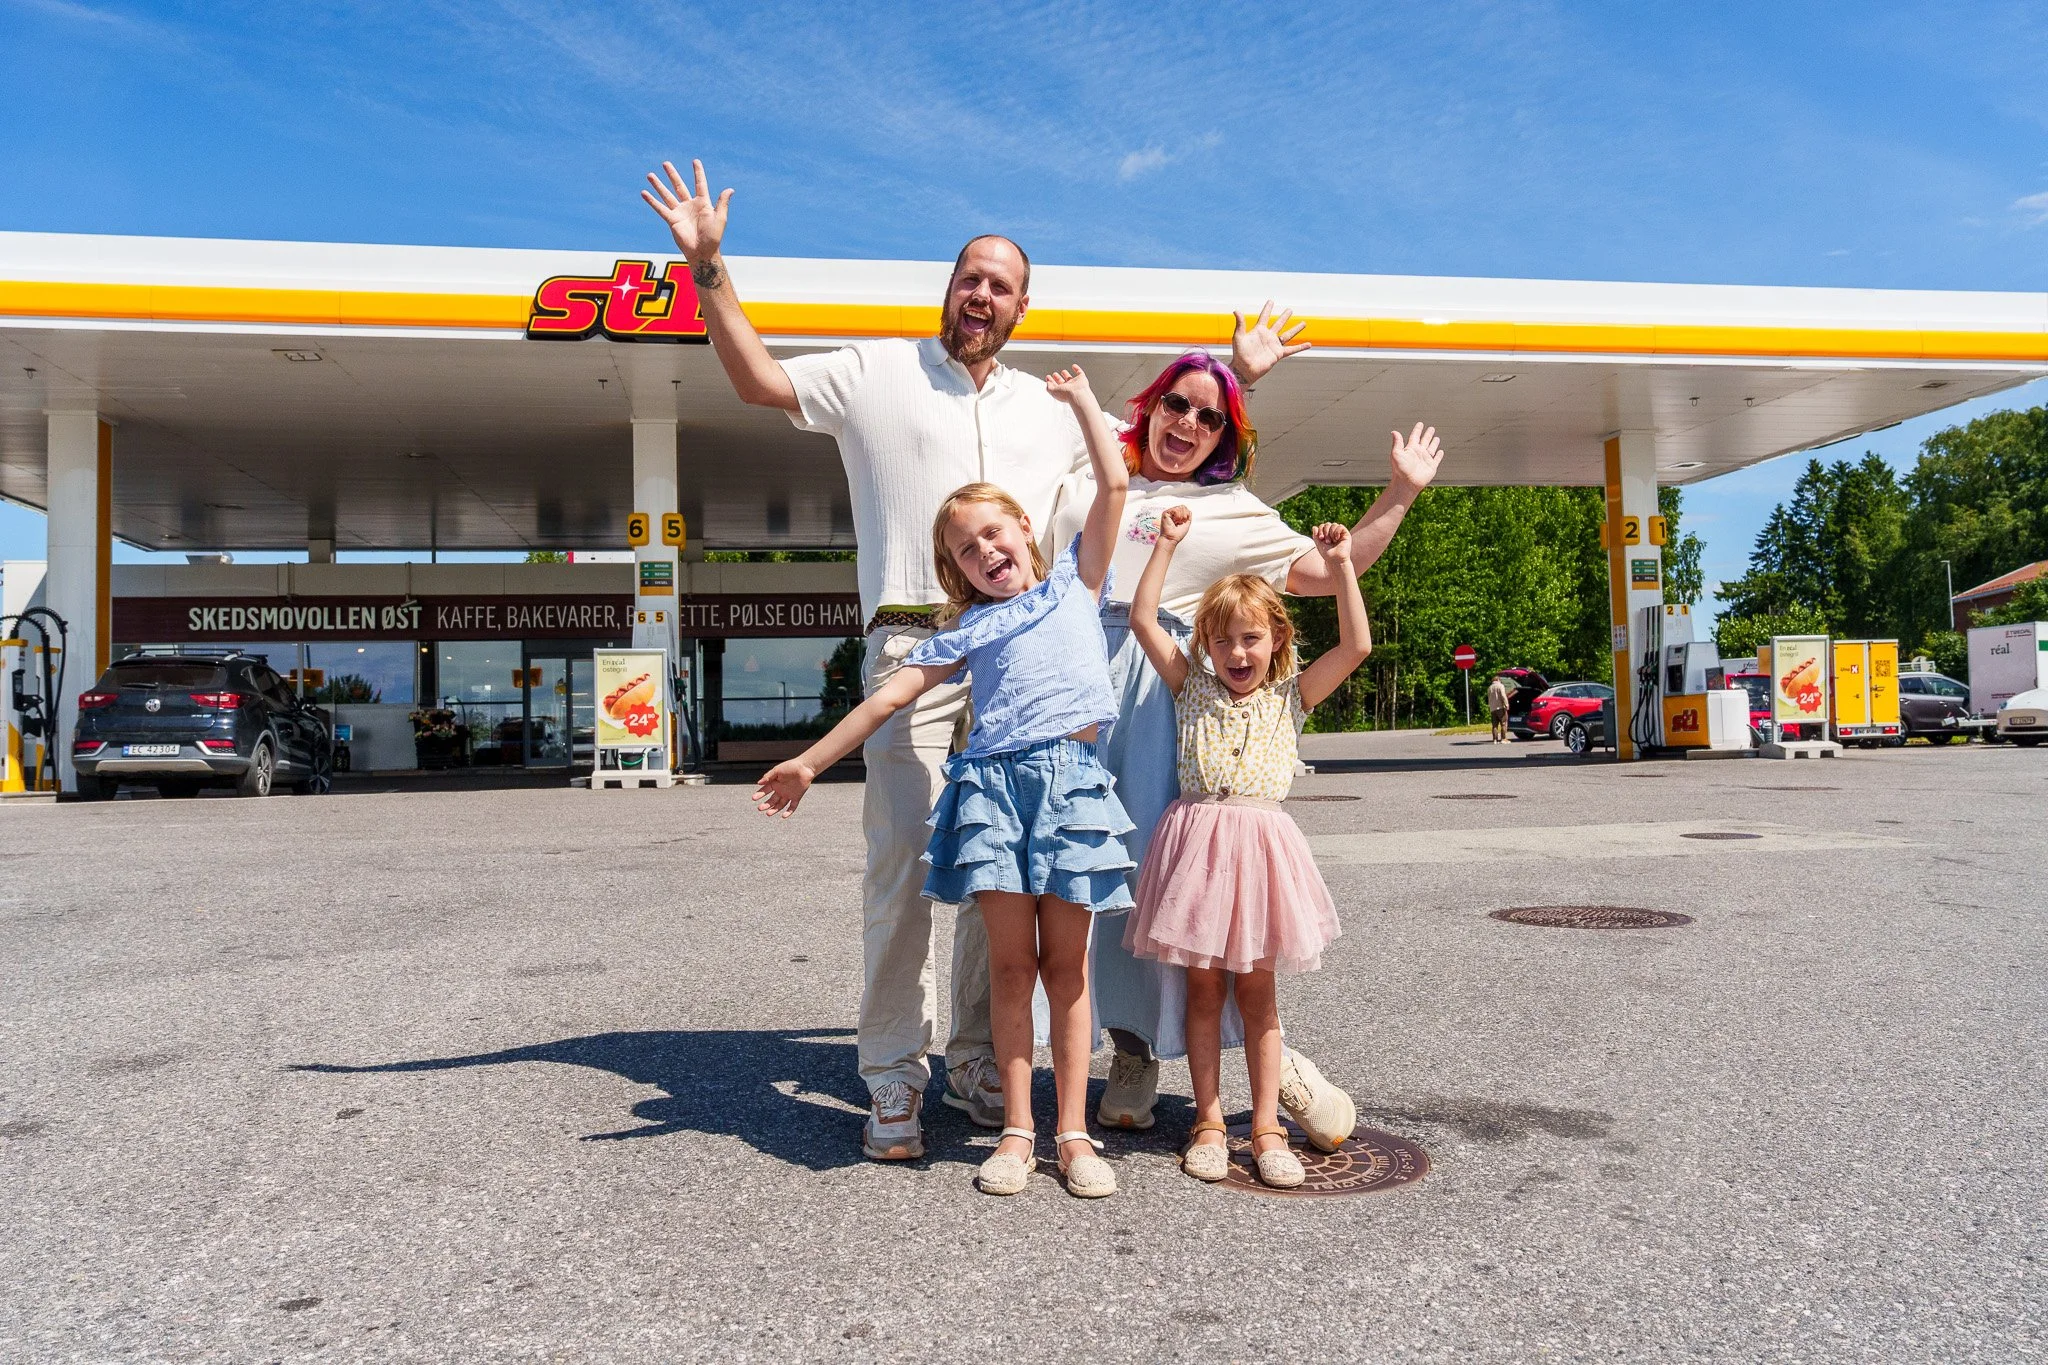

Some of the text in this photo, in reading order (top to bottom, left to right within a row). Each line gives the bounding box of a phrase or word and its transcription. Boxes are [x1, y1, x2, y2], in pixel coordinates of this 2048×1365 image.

[528, 260, 708, 337] st1
[629, 519, 643, 538] 6
[667, 519, 681, 538] 5
[1625, 521, 1639, 539] 2
[1658, 522, 1666, 538] 1
[188, 605, 422, 631] SKEDSMOVOLLEN ØST
[437, 605, 502, 631] KAFFE,
[507, 604, 621, 631] BAKEVARER,
[730, 603, 785, 627] PØLSE
[791, 604, 814, 626] OG
[820, 604, 864, 626] HAM
[638, 613, 646, 622] 6
[656, 612, 664, 622] 5
[1666, 606, 1674, 615] 2
[1990, 643, 2010, 656] réal
[1671, 708, 1700, 733] st1
[147, 745, 176, 753] 42304
